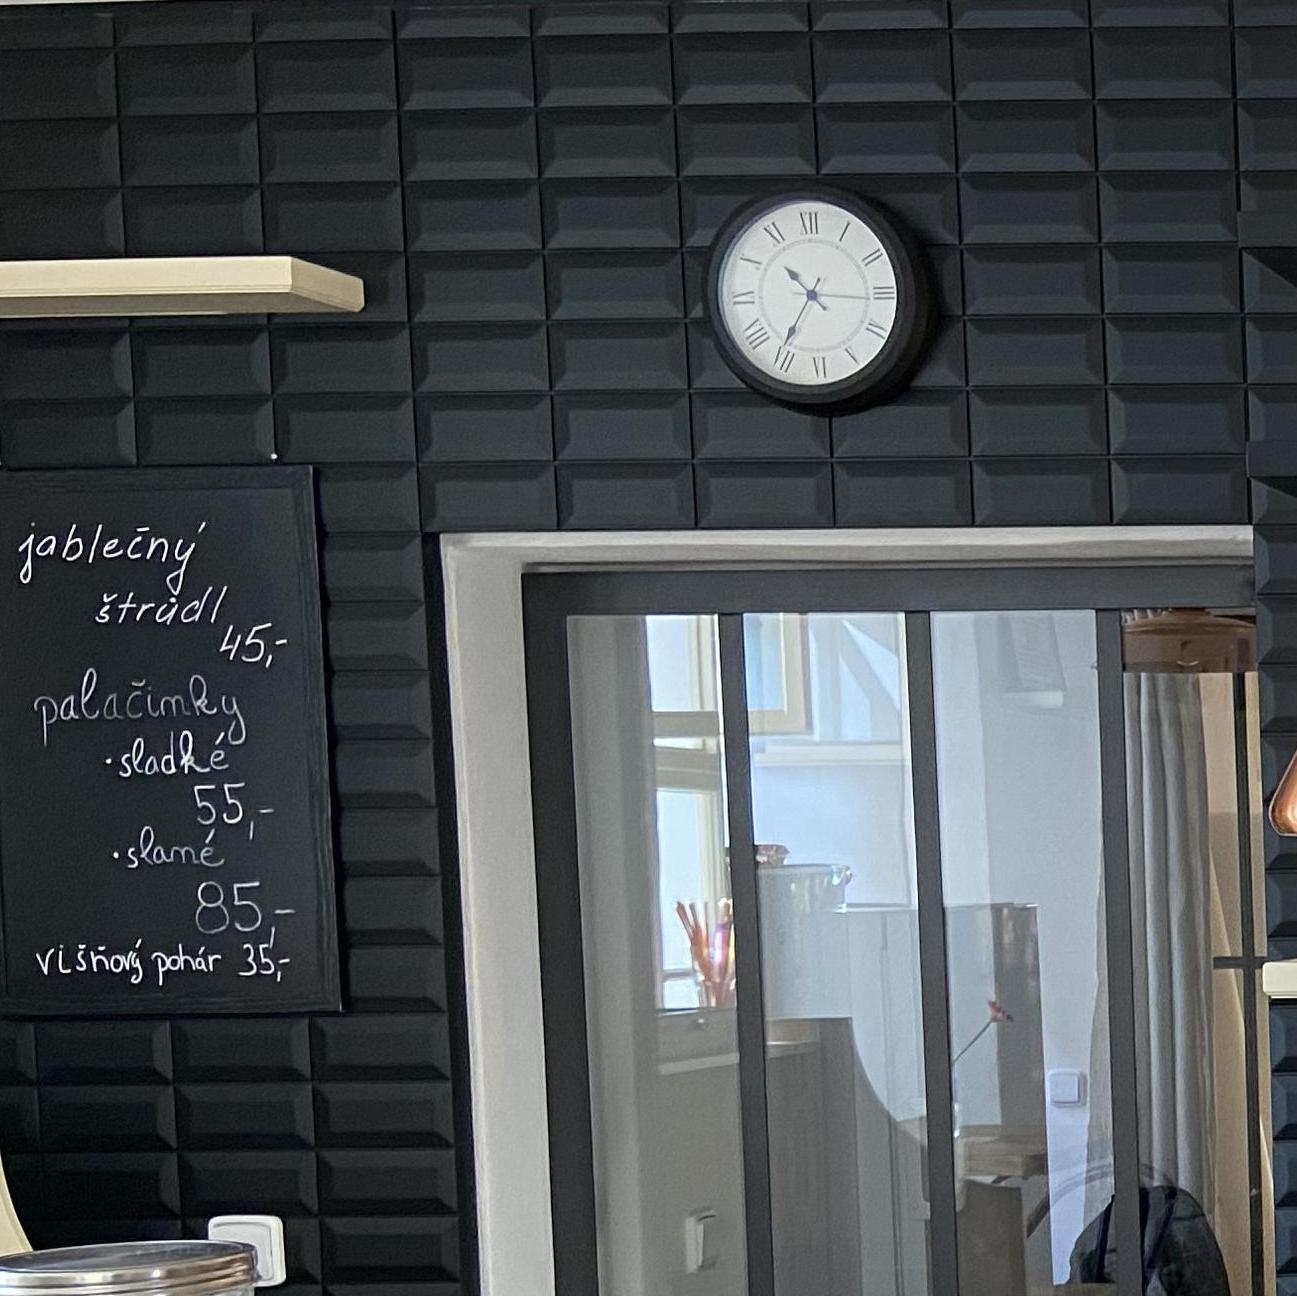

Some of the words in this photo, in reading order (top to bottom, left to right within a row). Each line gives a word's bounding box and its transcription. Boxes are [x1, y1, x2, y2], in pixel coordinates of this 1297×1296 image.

[18, 521, 207, 596] jablečný
[95, 585, 228, 626] štrůdl
[219, 623, 288, 668] 45,-
[33, 667, 247, 747] palačinky
[119, 729, 230, 778] sladké
[193, 782, 275, 841] 55,-
[127, 825, 226, 869] slané
[195, 880, 297, 949] 85,-
[35, 937, 143, 985] višňový
[151, 943, 222, 986] pohár
[237, 943, 291, 983] 35,-
